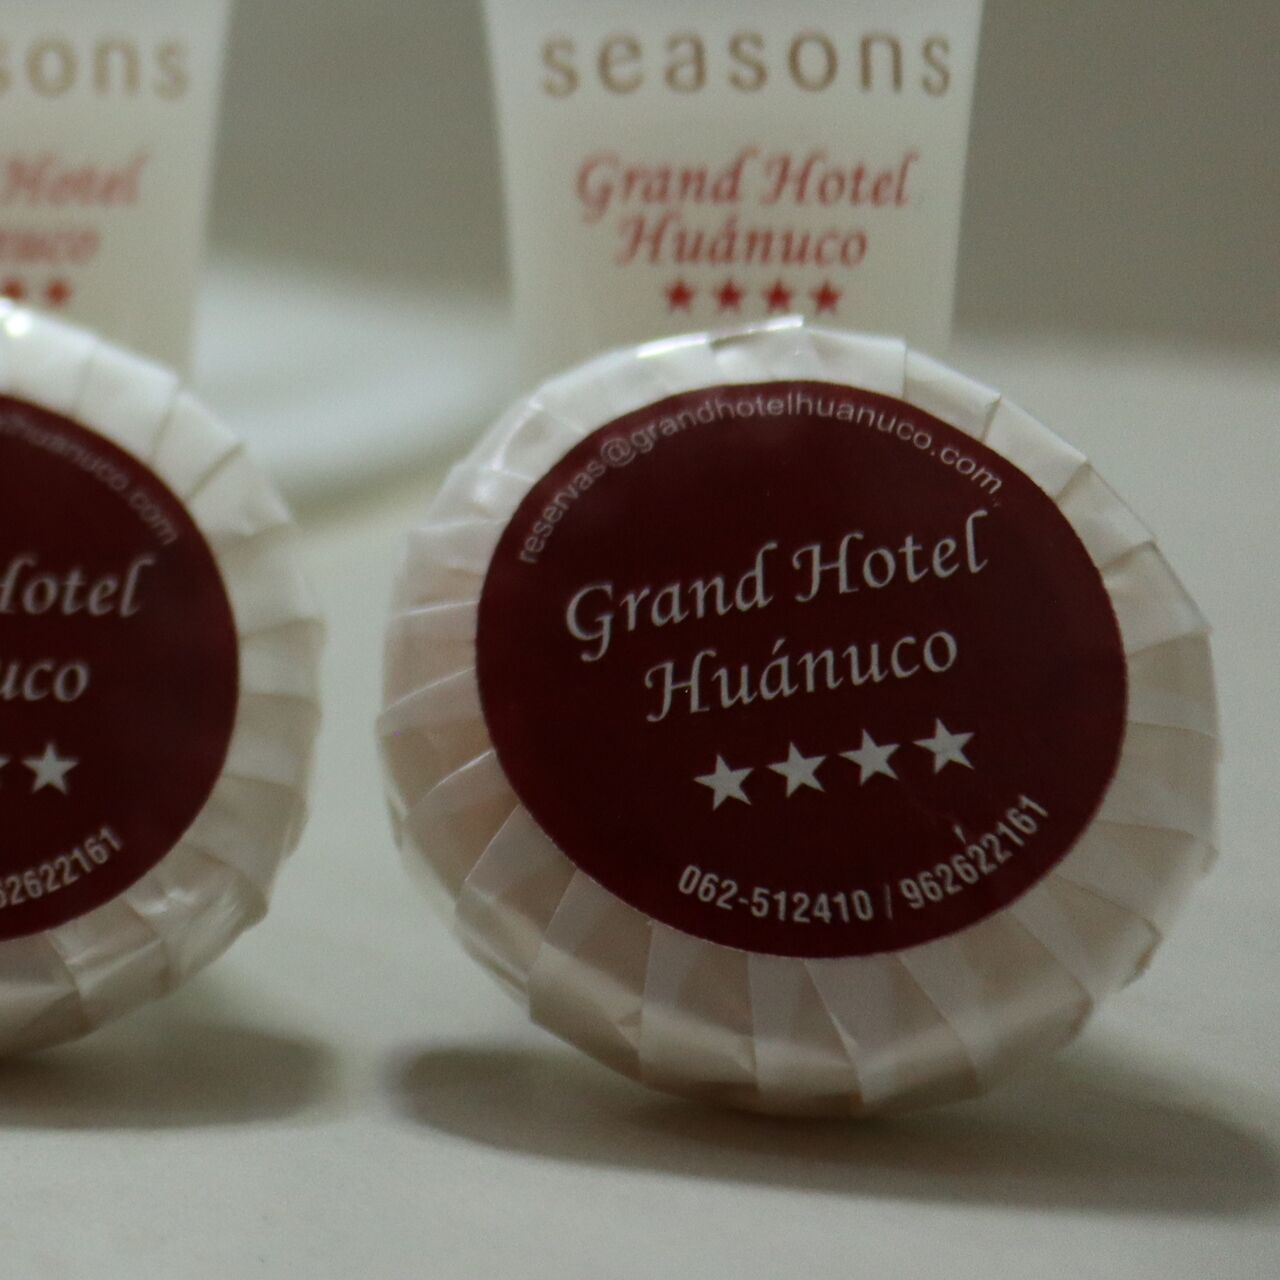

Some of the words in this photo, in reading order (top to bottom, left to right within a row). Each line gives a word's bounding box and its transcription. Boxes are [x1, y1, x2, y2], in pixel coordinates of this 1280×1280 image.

[542, 30, 952, 99] seasons
[575, 144, 762, 226] Grand
[758, 148, 920, 210] Hotel
[615, 215, 869, 269] Huánuco
[519, 391, 1004, 565] reservas@grandhotelhuanuco.com
[564, 540, 779, 663] Grand
[792, 509, 989, 604] Hotel
[643, 628, 959, 723] Huánuco
[677, 864, 874, 924] 062-512410
[899, 793, 1049, 910] 962622161
